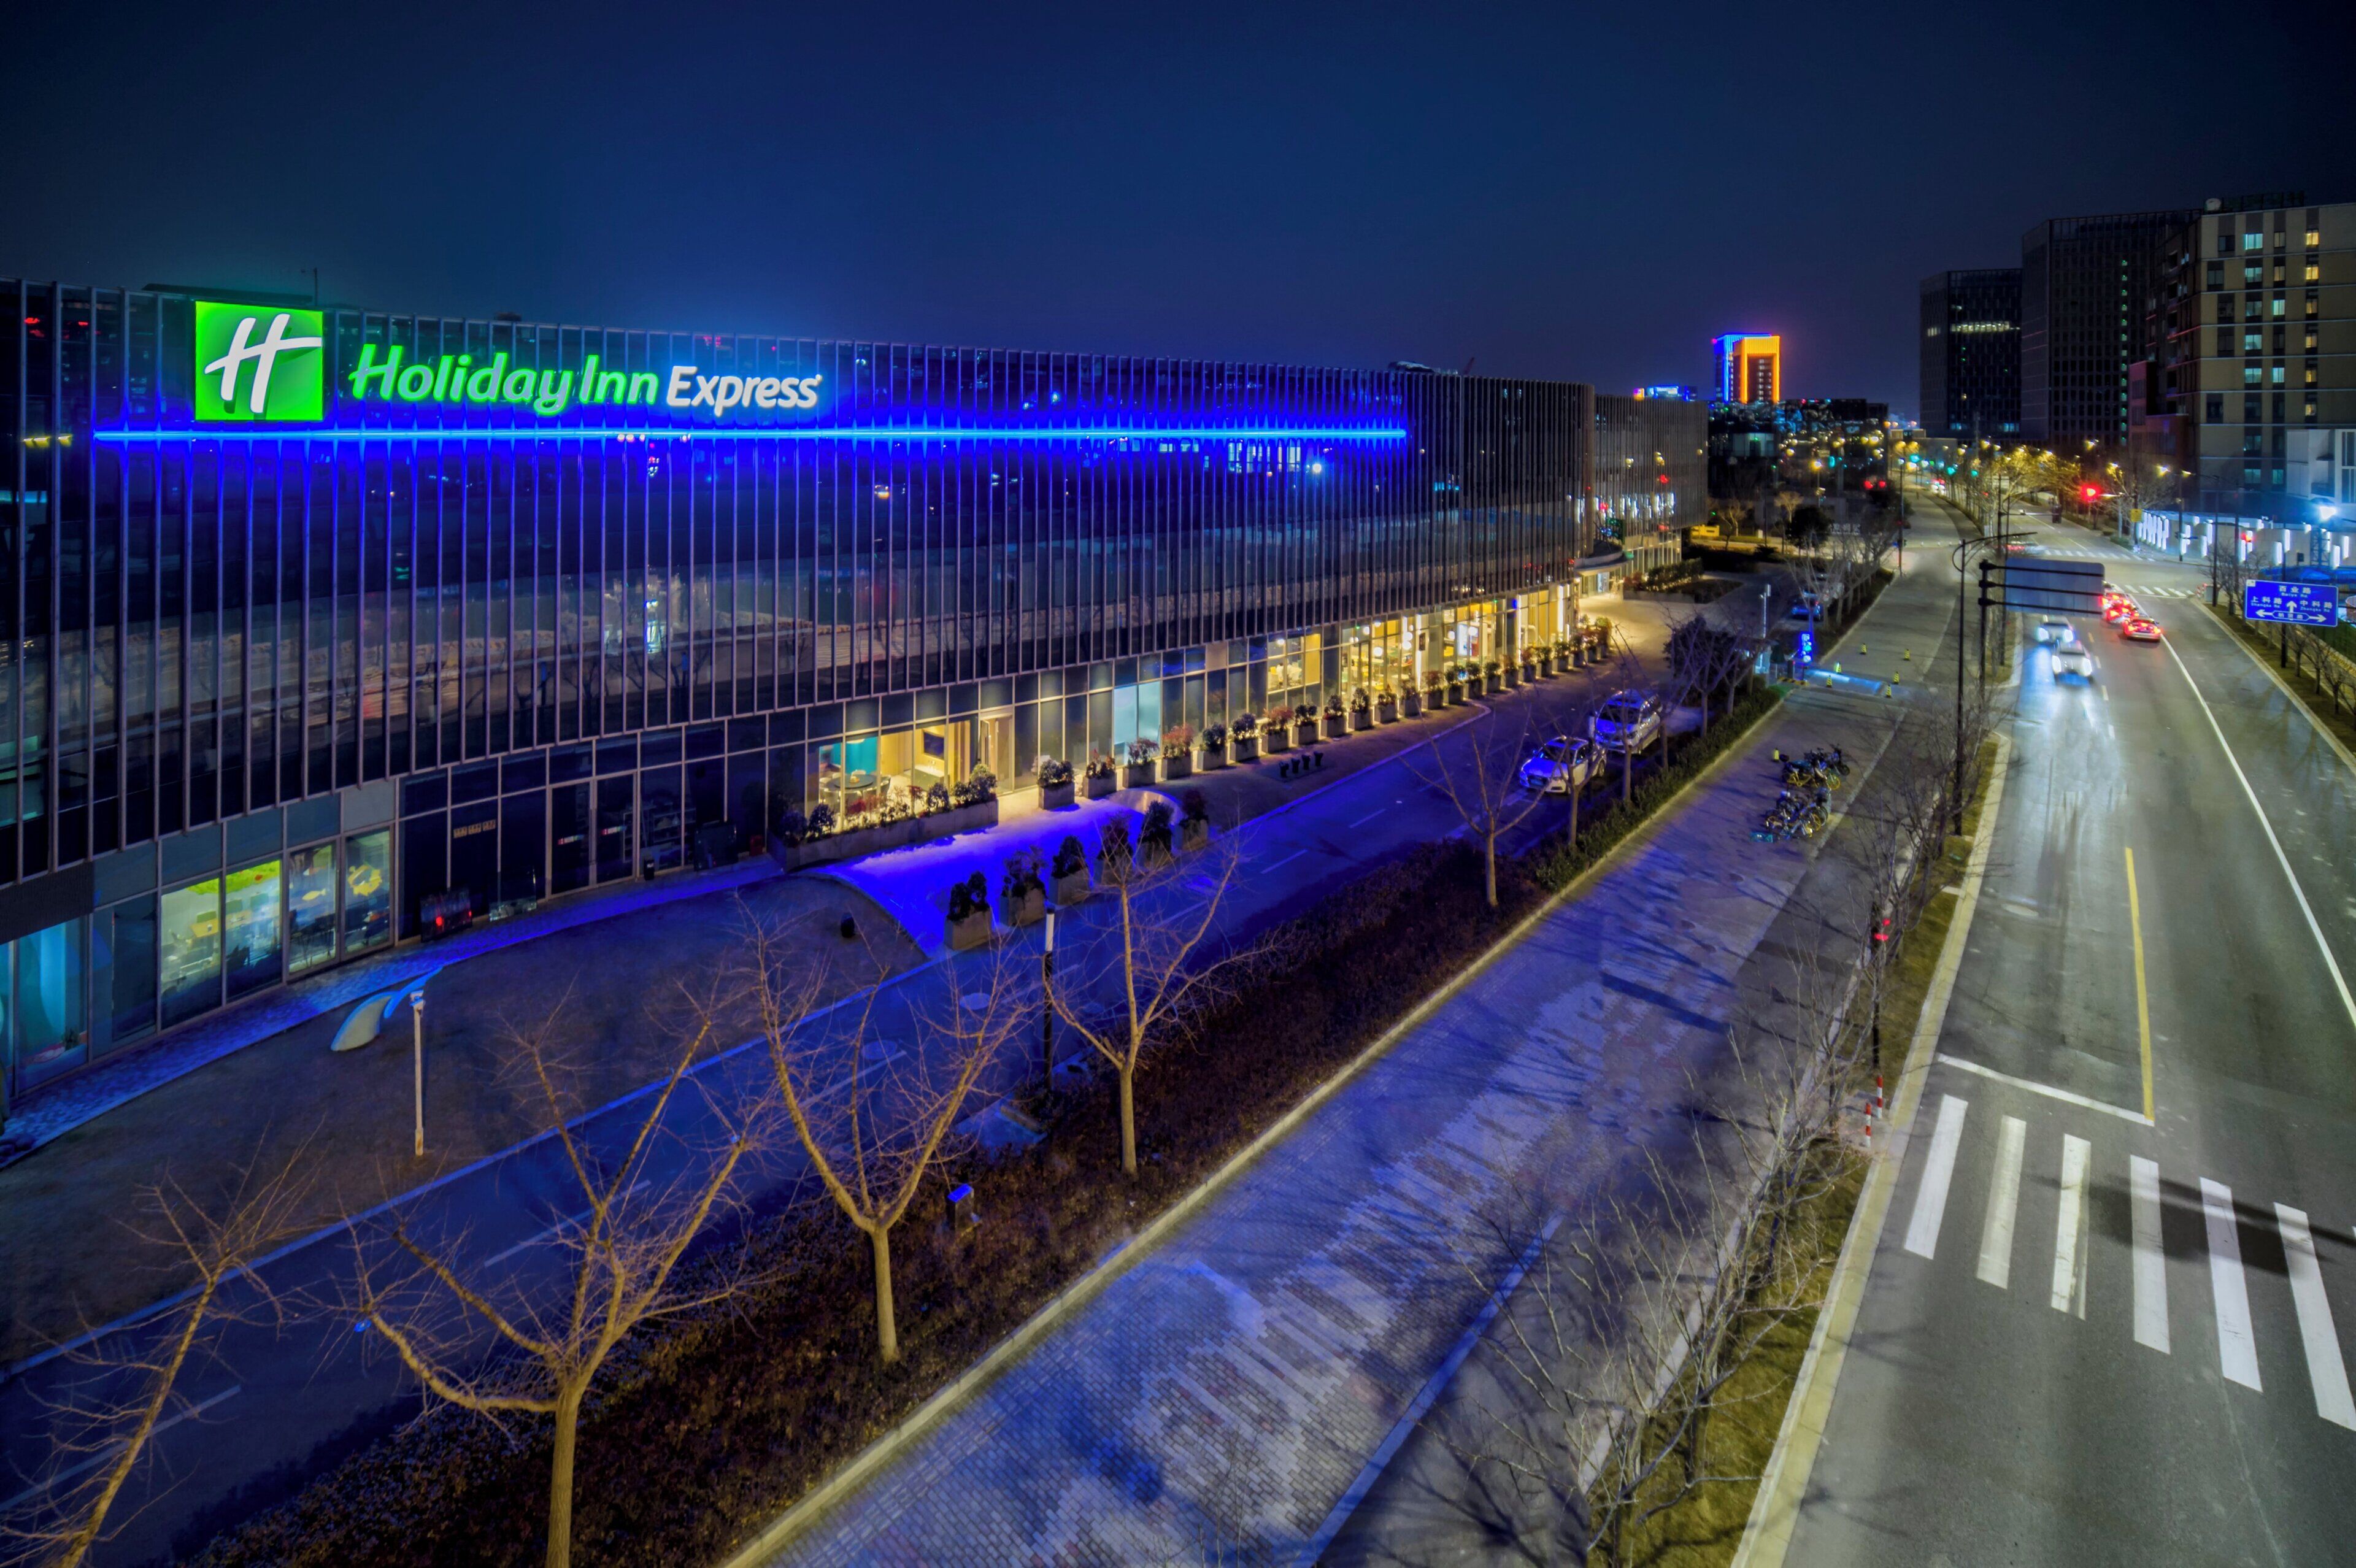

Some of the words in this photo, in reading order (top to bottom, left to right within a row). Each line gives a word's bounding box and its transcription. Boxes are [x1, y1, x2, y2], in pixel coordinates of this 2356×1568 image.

[348, 344, 573, 416] Holiday
[579, 355, 659, 404] Inn
[666, 365, 822, 417] Express
[2250, 596, 2282, 605] 上科路
[2300, 600, 2333, 609] 中科路
